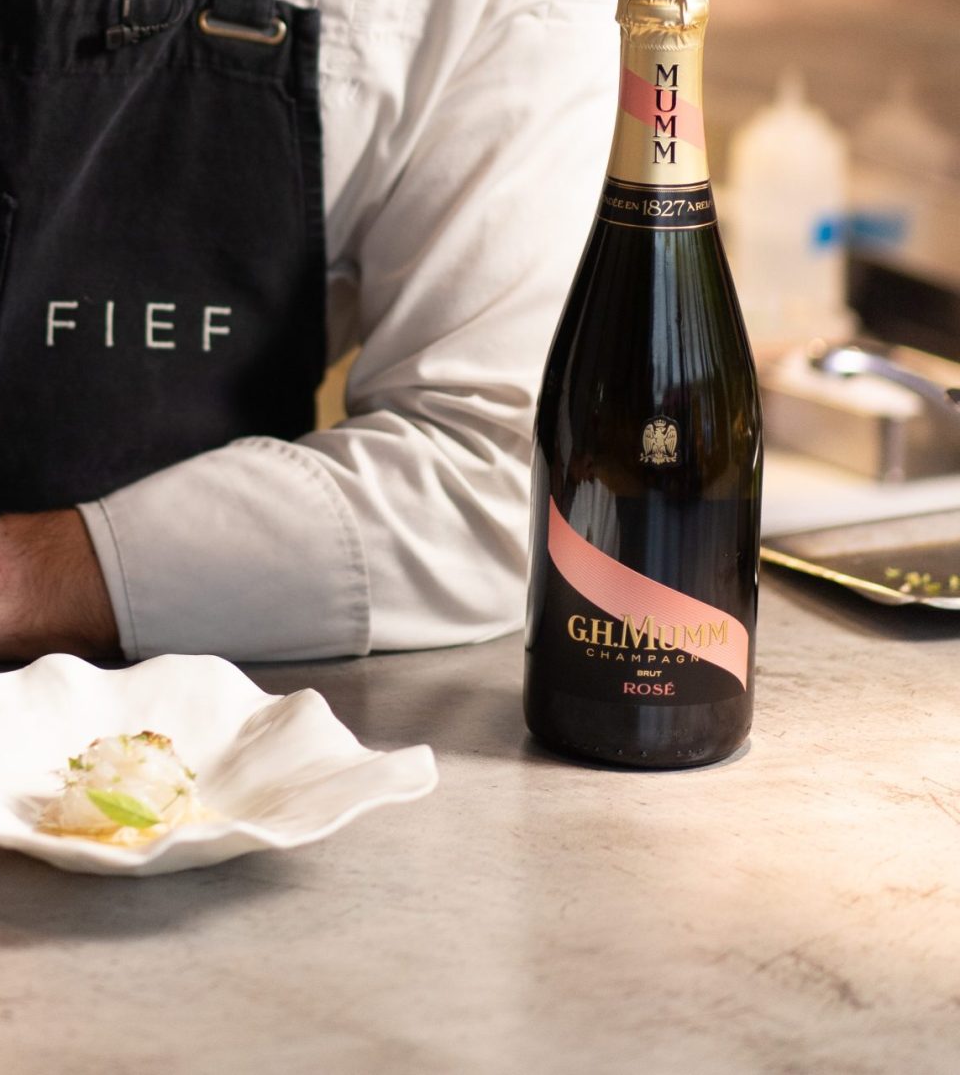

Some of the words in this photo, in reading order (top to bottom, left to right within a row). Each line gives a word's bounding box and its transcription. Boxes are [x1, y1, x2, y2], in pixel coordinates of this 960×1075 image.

[652, 63, 679, 164] MUMM
[642, 199, 686, 216] 1827
[46, 300, 232, 352] FIEF
[636, 669, 662, 677] BRUT
[623, 681, 676, 696] ROSÉ
